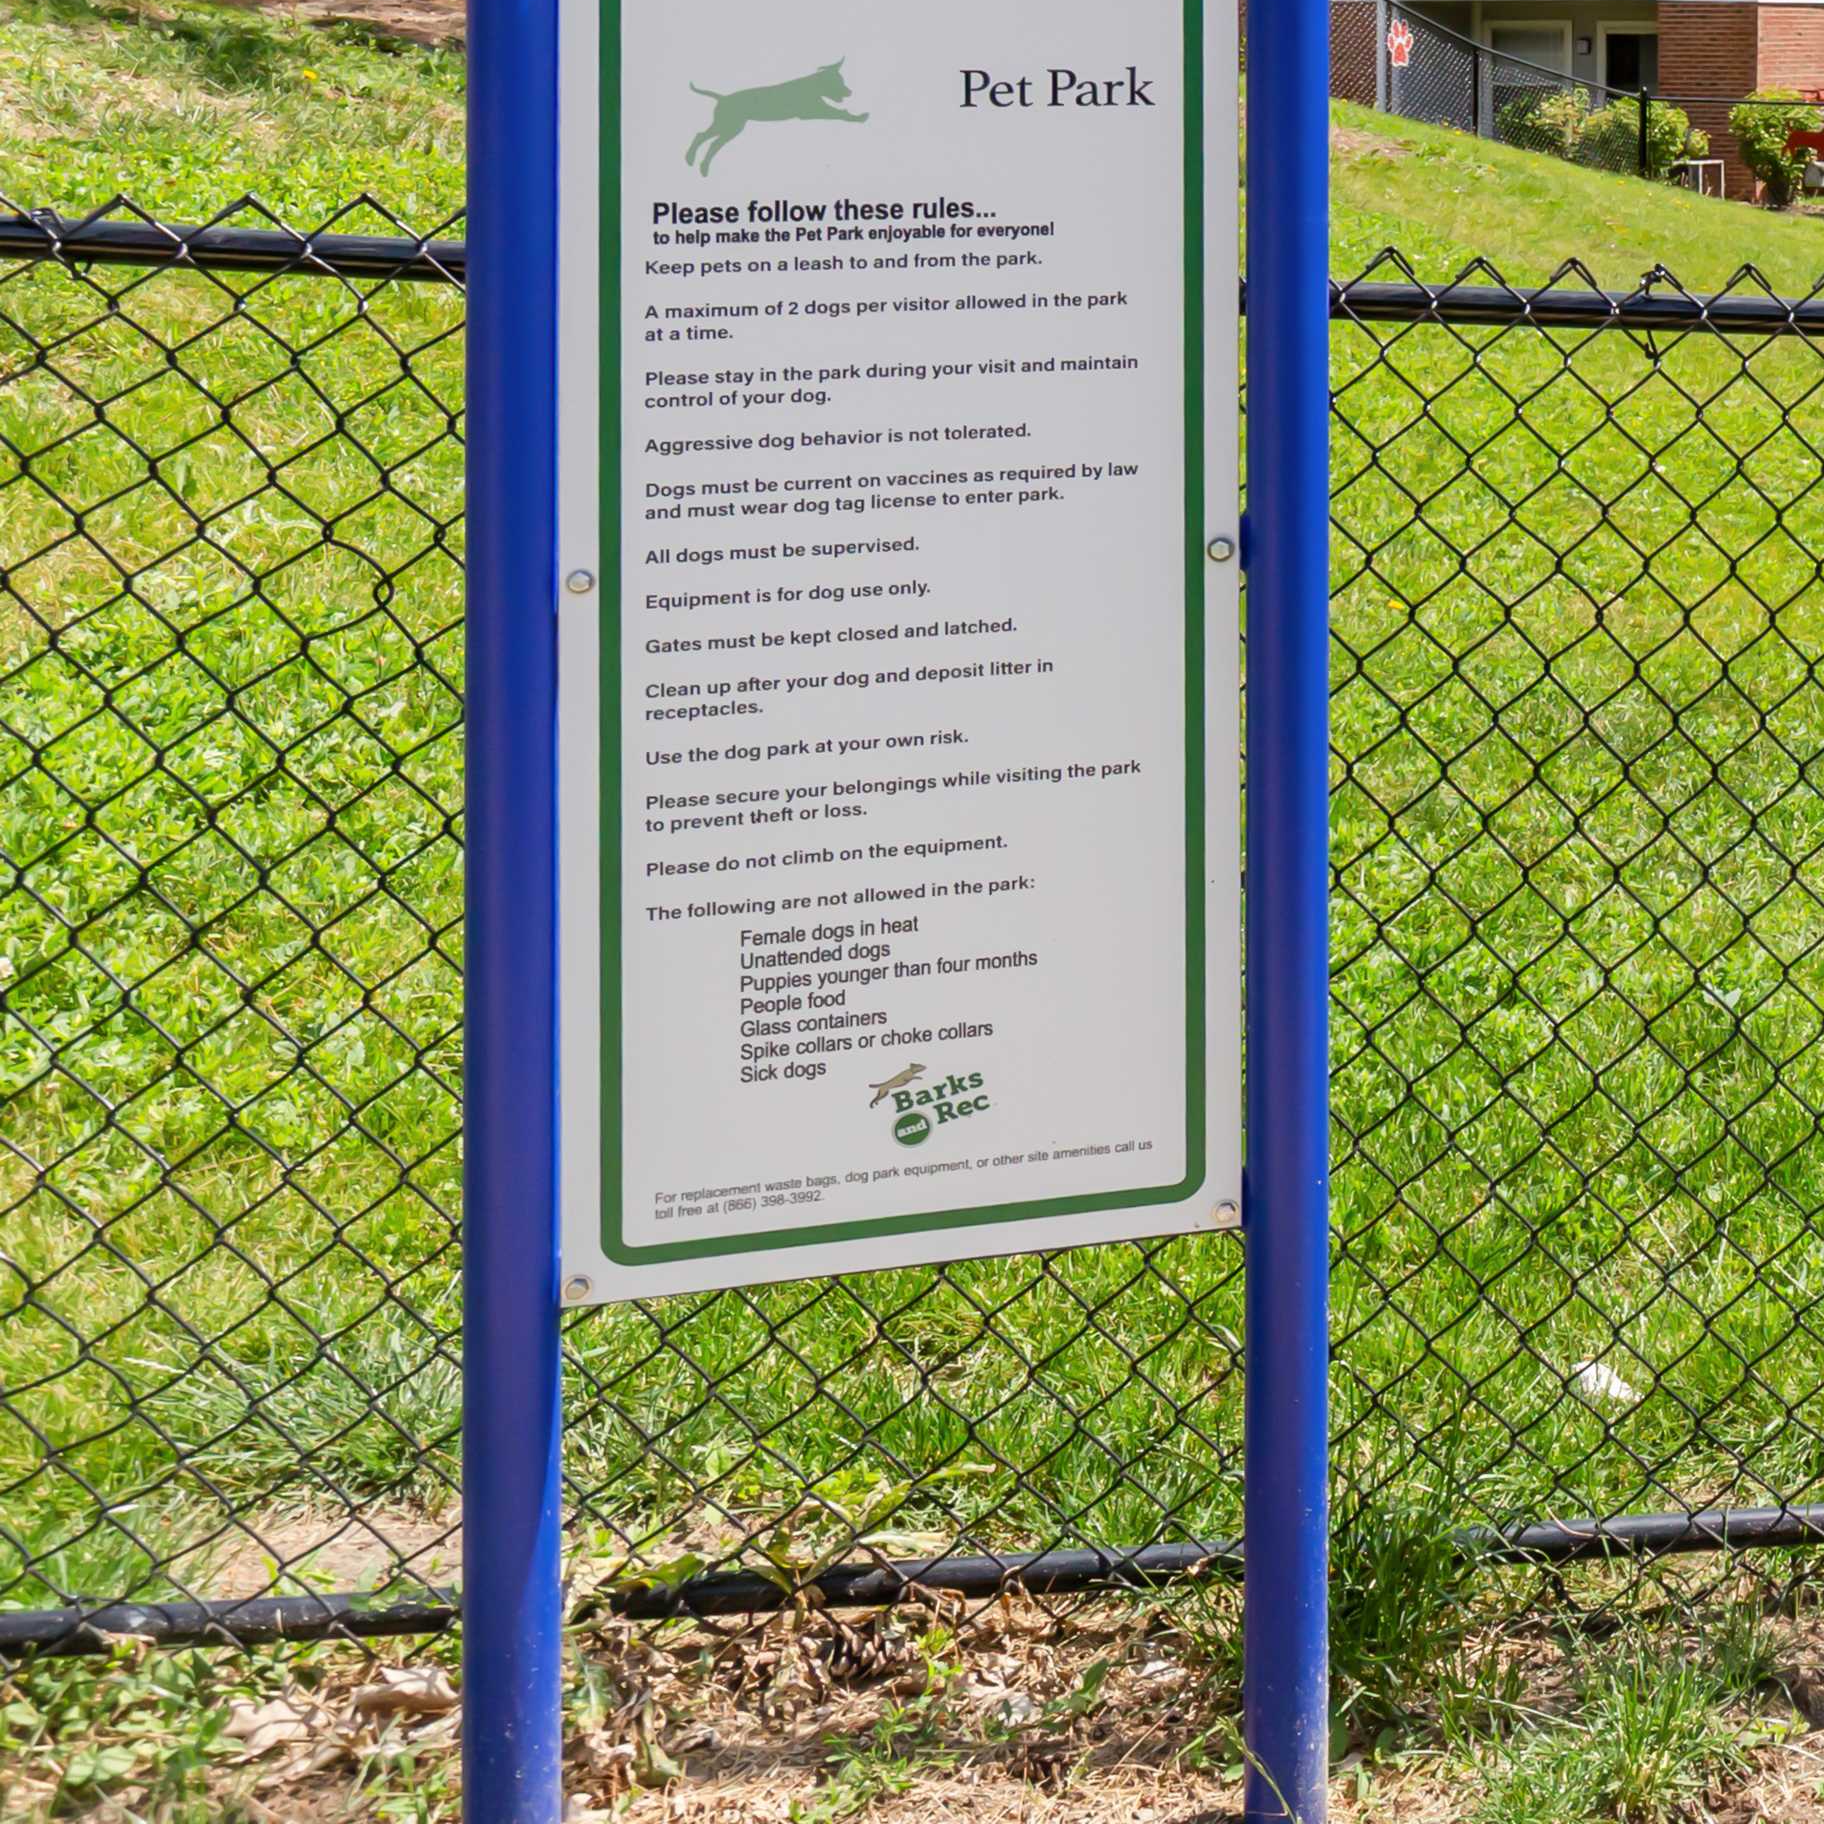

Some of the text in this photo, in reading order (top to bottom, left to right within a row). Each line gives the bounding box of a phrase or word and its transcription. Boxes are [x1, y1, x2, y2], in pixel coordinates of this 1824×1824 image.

[959, 65, 1157, 108] Pet Park
[652, 196, 997, 225] Please follow these rules...
[652, 220, 1055, 248] to help make the Pet Park enjoyable for everyone!
[645, 250, 1043, 278] Keep pets on a leash to and from the park.
[644, 290, 1128, 320] A maximum of 2 dogs per visitor allowed in the park
[644, 324, 734, 342] at a time.
[645, 354, 1139, 387] Please stay in the park during your visit and maintain
[644, 387, 832, 409] control of your dog.
[644, 422, 1032, 457] Aggressive dog behavior is not tolerated.
[645, 579, 931, 612] Equipment is for dog use only.
[644, 617, 1017, 655] Gates must be kept closed and latched.
[645, 658, 1054, 699] Clean up after your dog and deposit litter in
[645, 699, 764, 722] receptacles.
[645, 728, 969, 766] Use the dog park at your own risk.
[646, 835, 1008, 878] Please do not climb on the equipment.
[645, 874, 1035, 922] The following are not allowed in the park:
[740, 942, 891, 970] Unattended dogs
[740, 950, 1038, 995] Puppies younger than four months
[740, 988, 846, 1016] People food
[739, 1010, 888, 1038] Glass containers
[740, 1021, 994, 1064] Spike collars or choke collars
[739, 1060, 827, 1084] Sick dogs
[890, 1071, 985, 1114] Barks
[895, 1093, 991, 1139] and Rec
[654, 1191, 678, 1205] For
[680, 1182, 762, 1203] replacement
[764, 1178, 803, 1194] waste
[844, 1170, 870, 1185] dog
[872, 1165, 901, 1183] park
[903, 1158, 973, 1178] equipment,
[975, 1157, 990, 1169] or
[992, 1154, 1025, 1167] other
[1027, 1150, 1050, 1163] site
[1052, 1144, 1112, 1161] amenities
[1114, 1139, 1136, 1154] call
[1137, 1140, 1153, 1151] us
[654, 1185, 829, 1220] toll free at (866) 398-3992.
